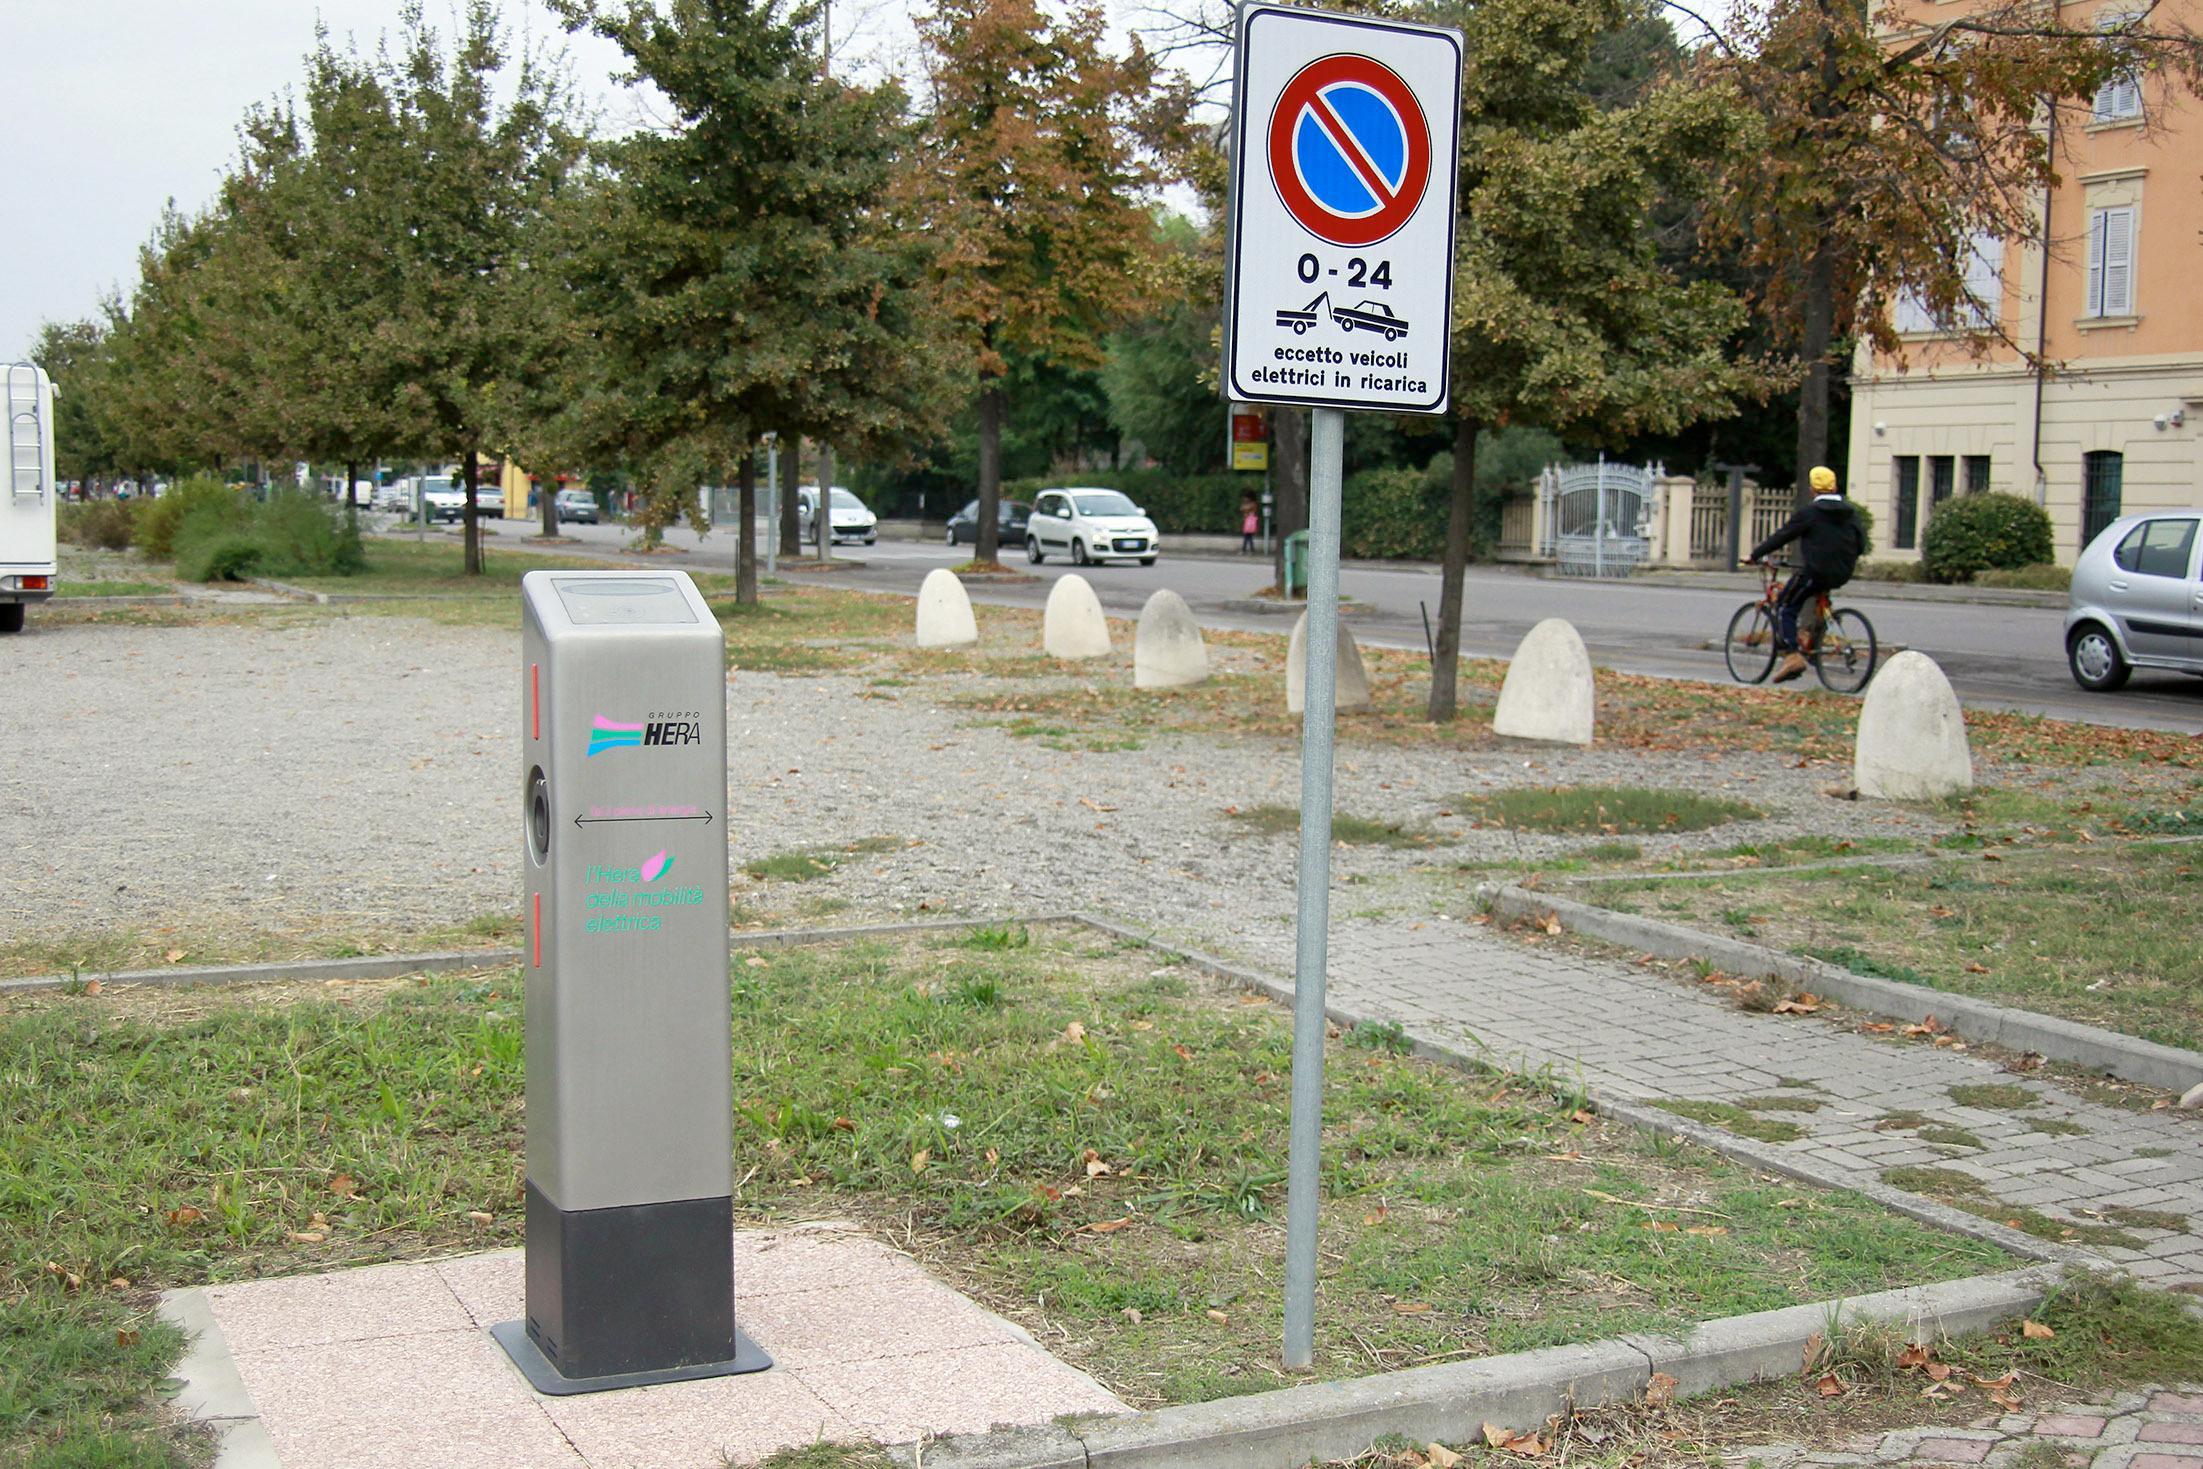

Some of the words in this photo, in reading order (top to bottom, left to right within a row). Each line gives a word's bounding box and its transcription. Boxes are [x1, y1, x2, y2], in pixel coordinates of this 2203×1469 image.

[1297, 253, 1320, 284] 0
[1347, 257, 1393, 290] 24
[1274, 347, 1343, 364] eccetto
[1350, 350, 1408, 369] veicoli
[1251, 366, 1325, 387] elettrici
[1335, 371, 1351, 388] in
[1361, 373, 1427, 393] ricarica
[648, 711, 701, 719] GRUPPO
[644, 722, 701, 746] HERA
[585, 887, 629, 909] della
[632, 885, 704, 907] mobilità
[585, 912, 662, 933] elettrica
